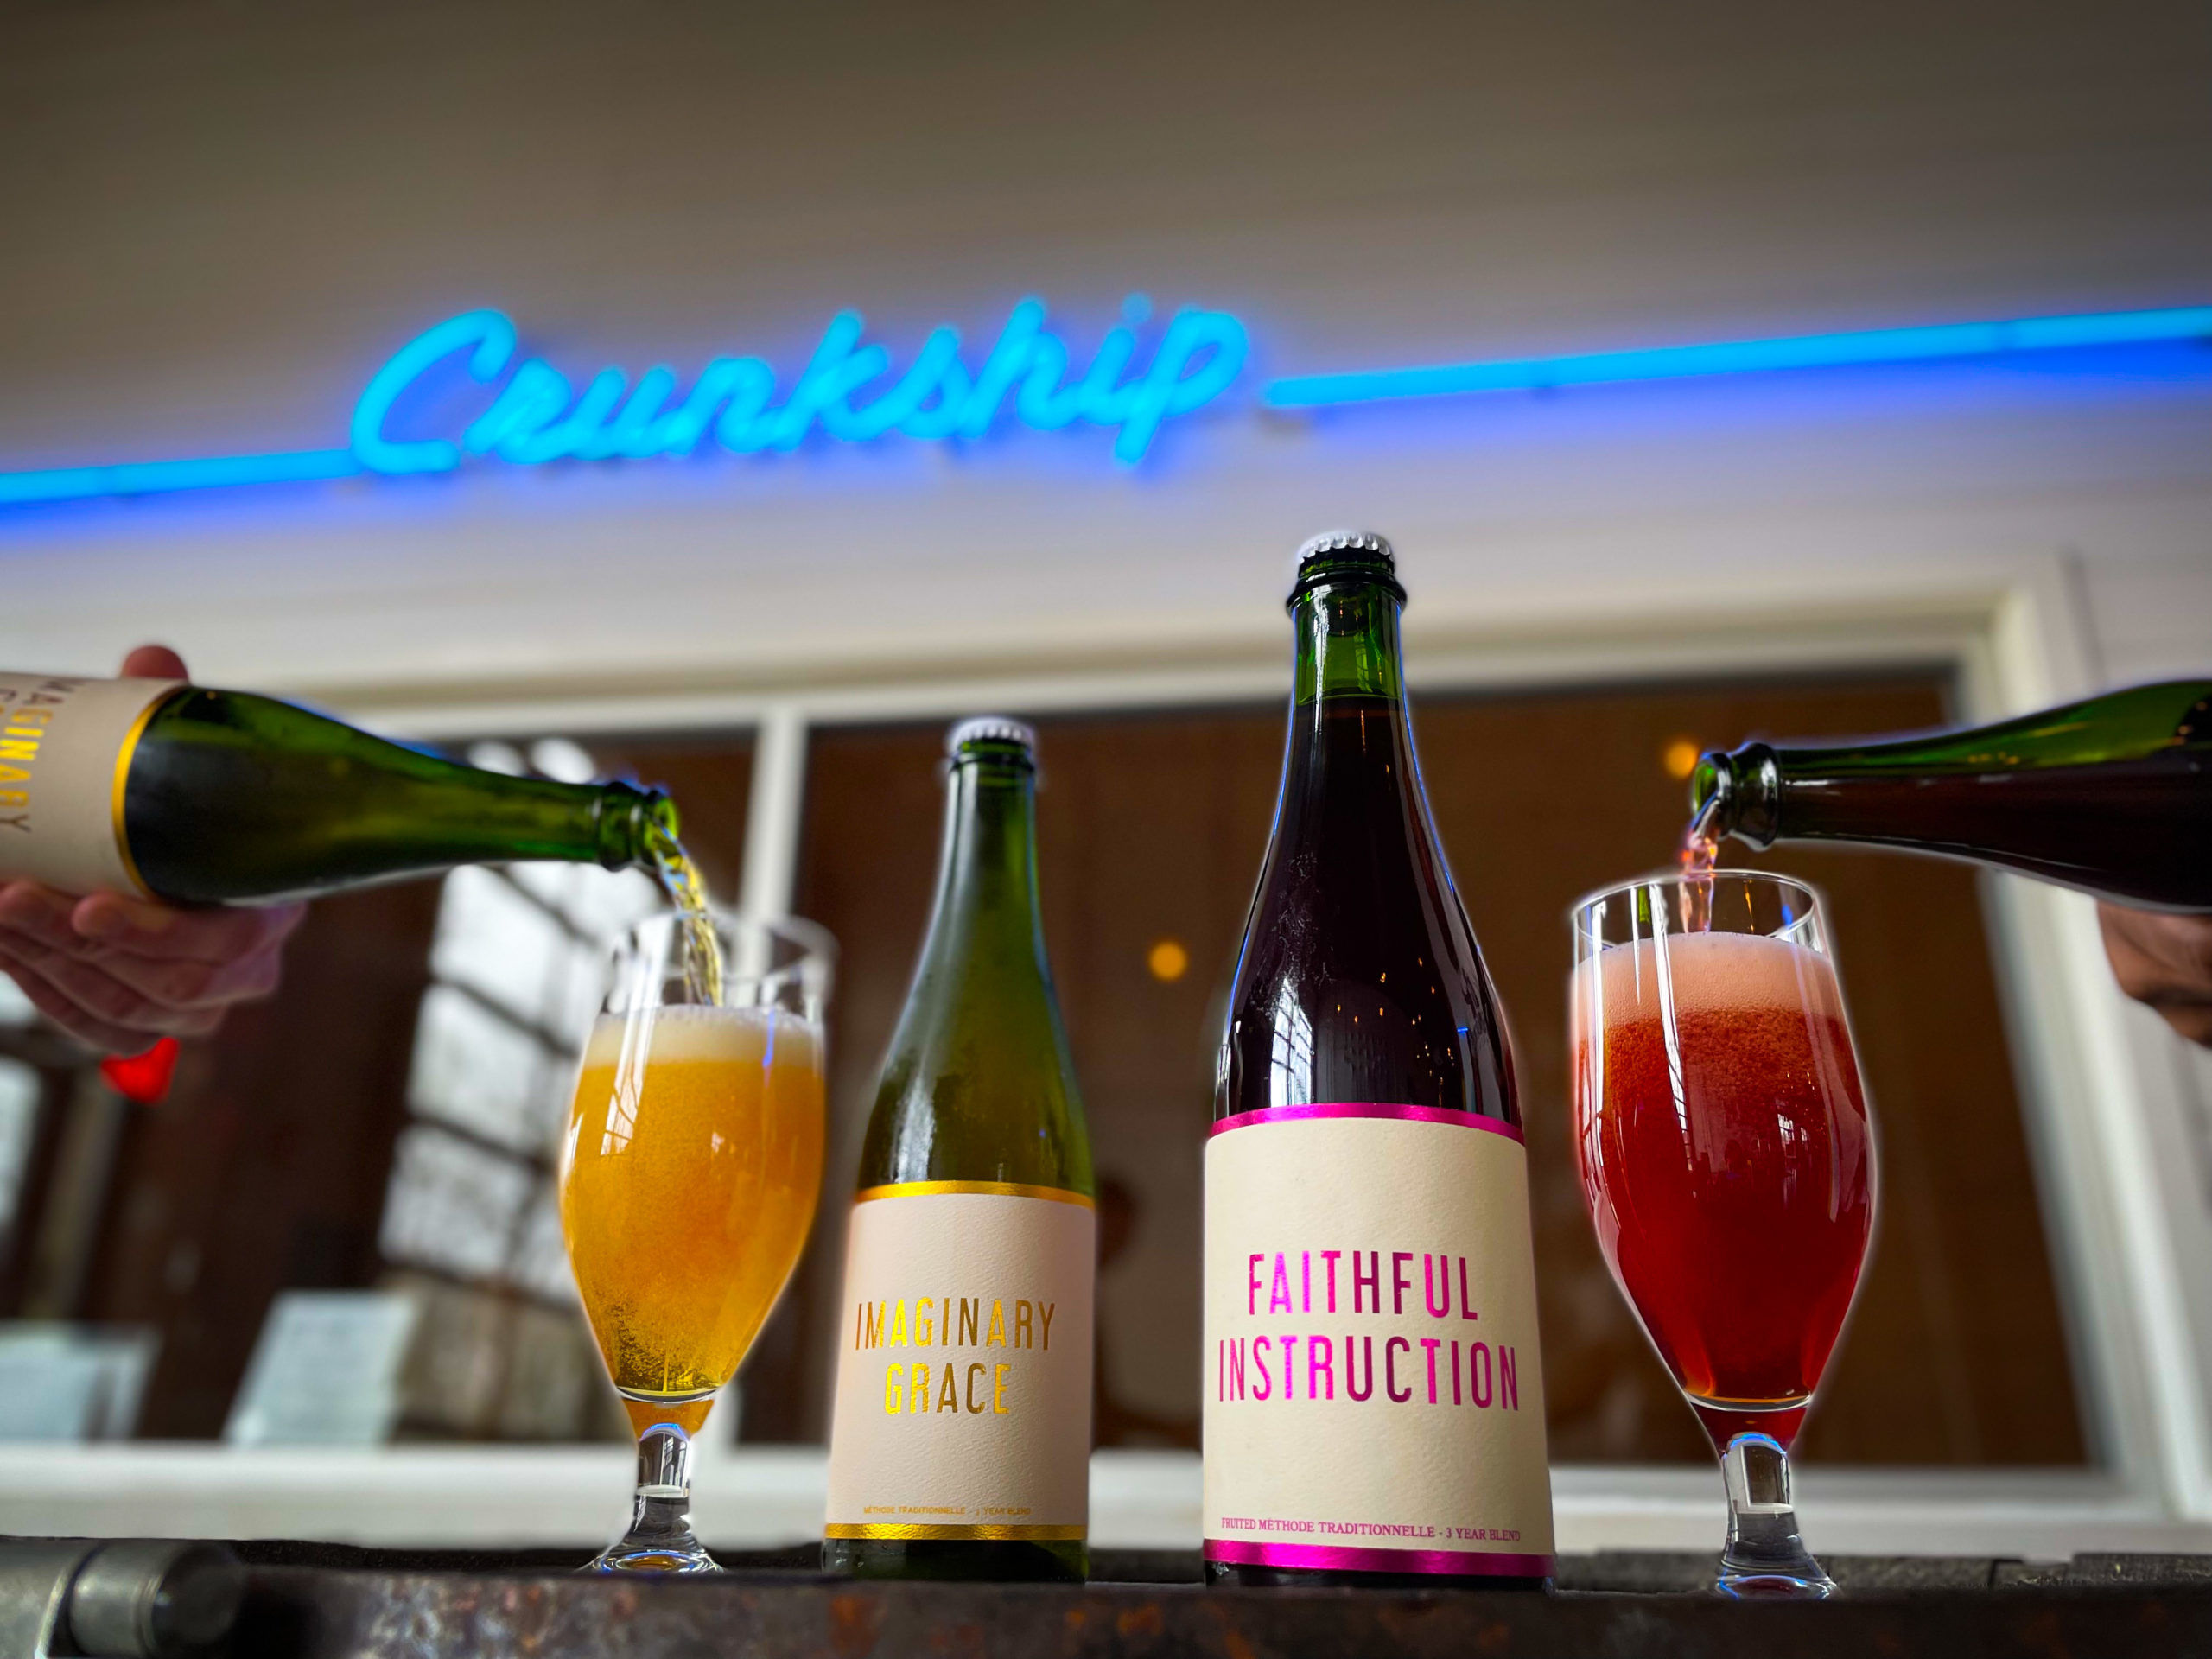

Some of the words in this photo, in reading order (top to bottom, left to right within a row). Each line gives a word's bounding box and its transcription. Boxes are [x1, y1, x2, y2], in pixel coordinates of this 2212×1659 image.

[351, 292, 1249, 468] Crunkship
[1249, 1250, 1478, 1320] FAITHFUL
[855, 1297, 1055, 1351] IMAGINARY
[884, 1362, 1011, 1414] GRACE
[1219, 1335, 1518, 1410] INSTRUCTION
[899, 1506, 966, 1515] TRADITIONNELLE
[1221, 1517, 1256, 1530] FRUITED
[1319, 1522, 1435, 1538] TRADITIONNELLE
[1446, 1528, 1452, 1538] 3
[1455, 1528, 1486, 1541] YEAR
[1489, 1529, 1521, 1541] BLEND
